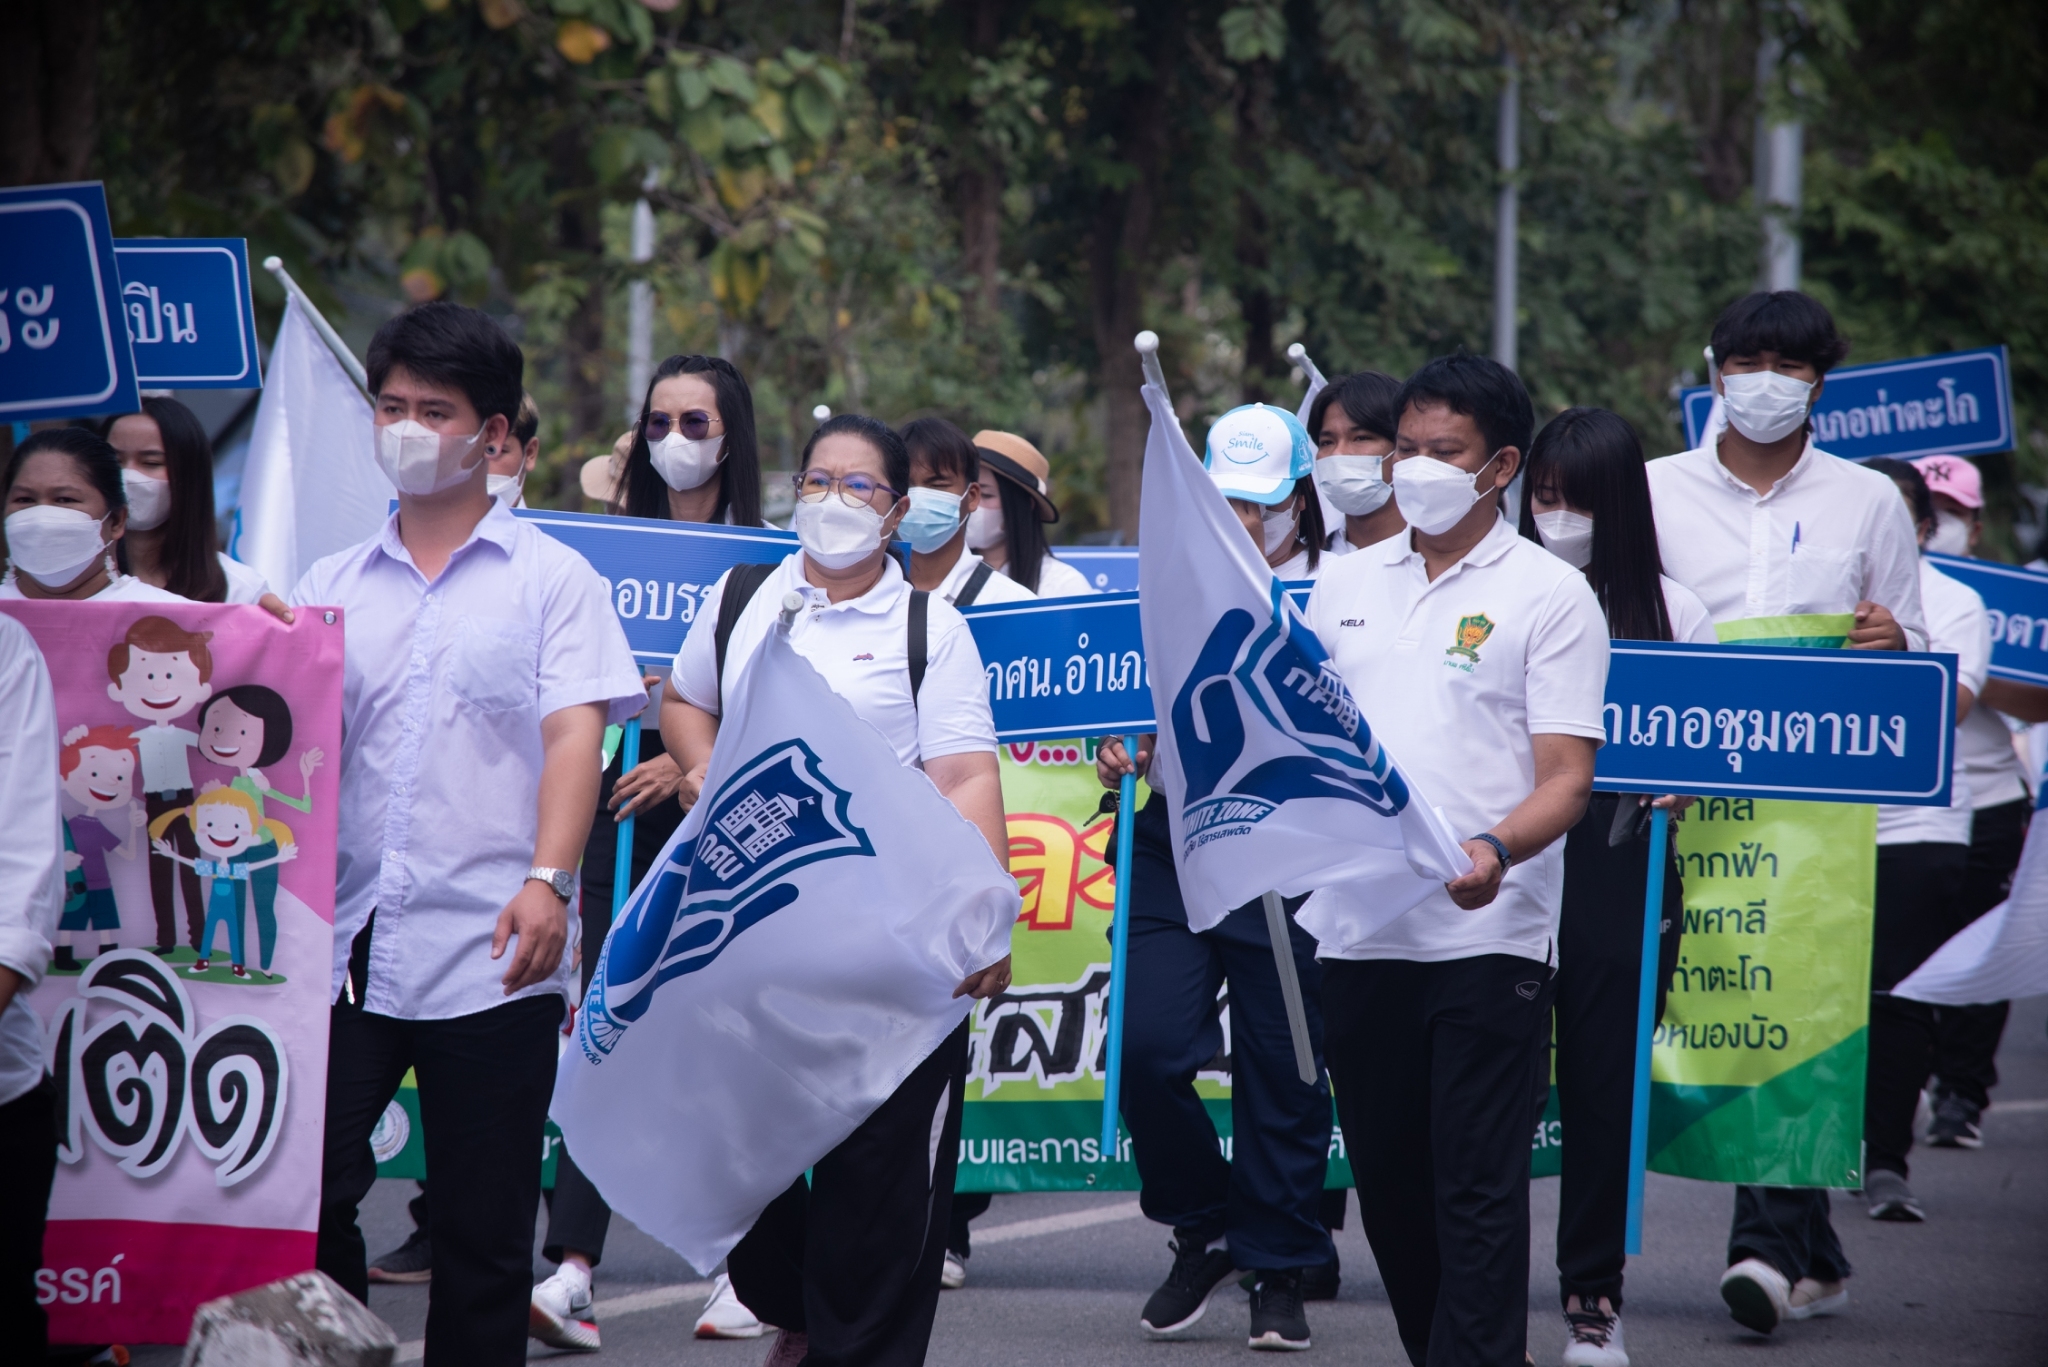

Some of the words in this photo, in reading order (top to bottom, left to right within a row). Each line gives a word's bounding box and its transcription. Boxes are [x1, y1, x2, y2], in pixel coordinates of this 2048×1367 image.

[1227, 437, 1264, 451] Smile
[985, 632, 1151, 700] กศน.อำเภ
[1213, 801, 1271, 824] ZONE
